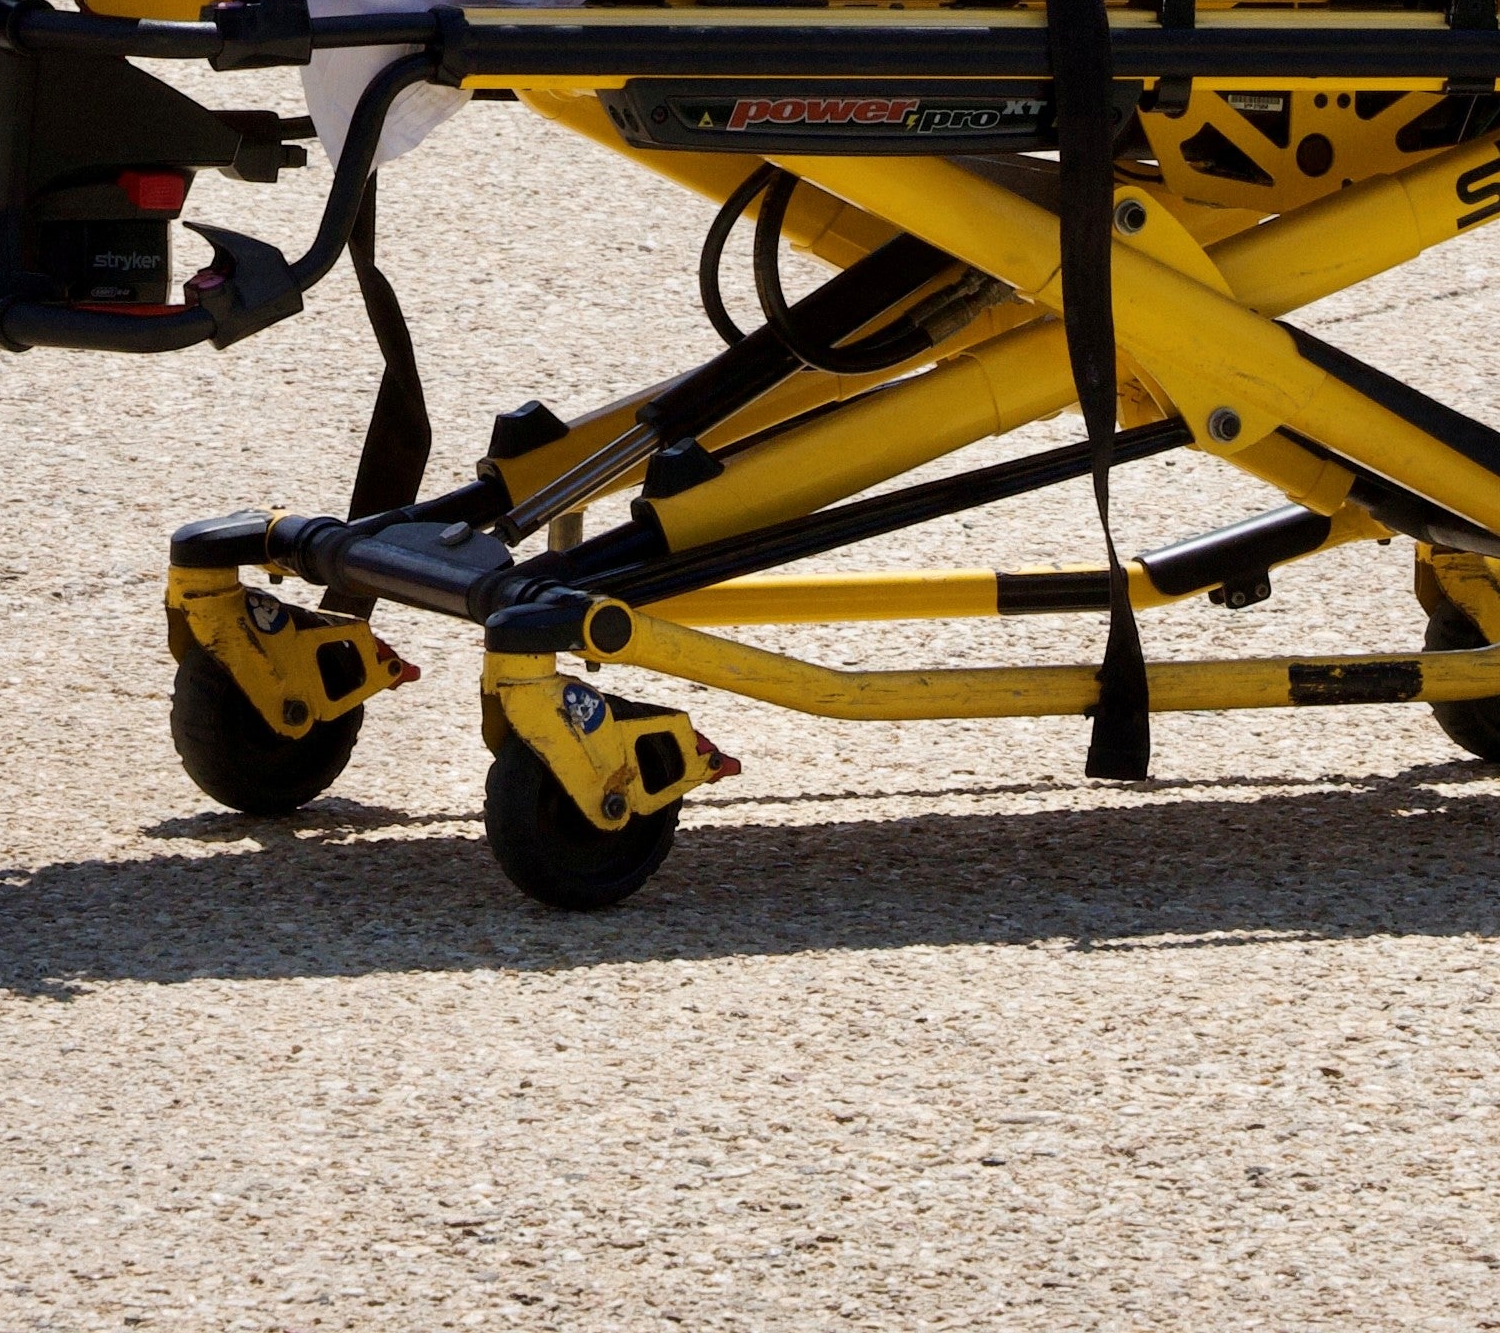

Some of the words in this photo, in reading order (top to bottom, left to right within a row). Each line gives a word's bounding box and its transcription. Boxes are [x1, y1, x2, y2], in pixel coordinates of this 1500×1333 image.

[726, 98, 919, 132] power
[917, 109, 1000, 134] pro
[1002, 99, 1048, 116] XT
[92, 250, 161, 271] stryker
